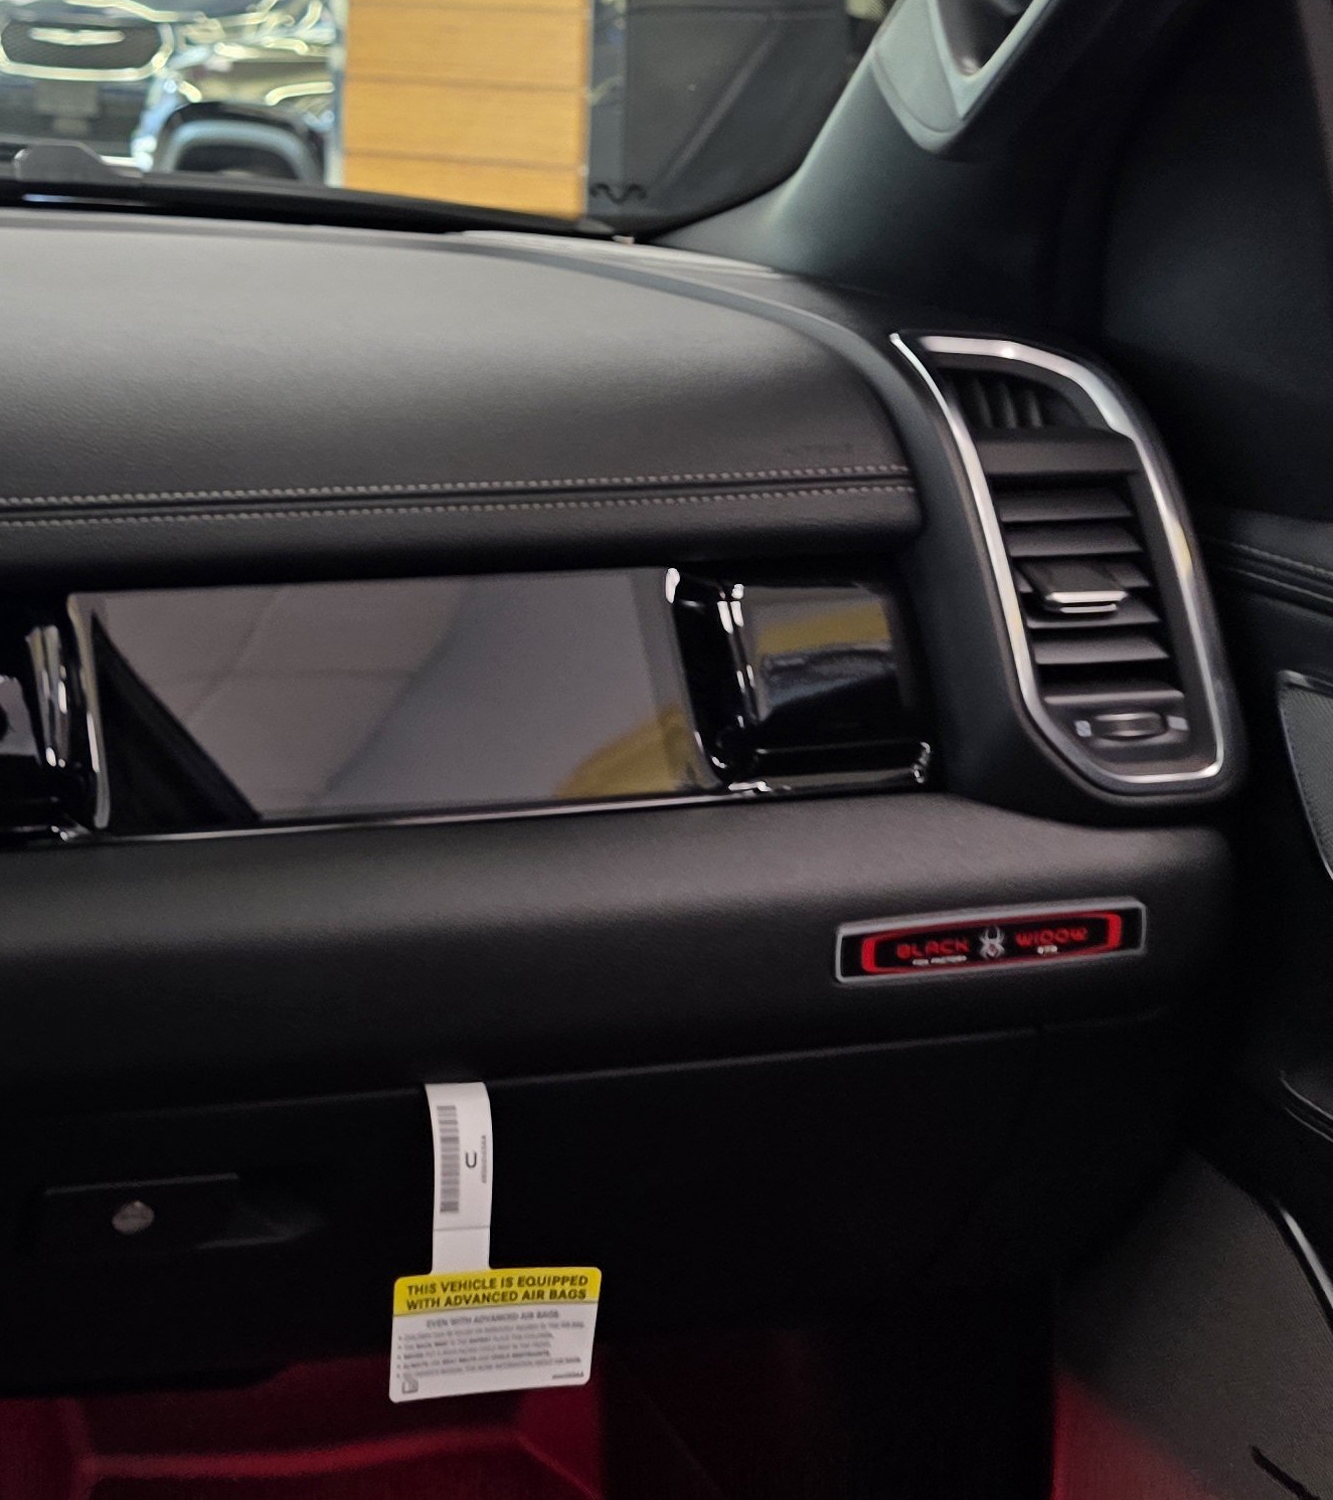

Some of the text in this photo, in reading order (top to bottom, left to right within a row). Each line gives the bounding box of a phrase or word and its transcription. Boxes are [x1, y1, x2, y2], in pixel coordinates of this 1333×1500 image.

[896, 927, 1089, 960] BLACK WIDOW
[406, 1274, 589, 1296] THIS VEHICLE IS EQUIPPED
[406, 1288, 587, 1311] WITH ADVANCED AIR BAGS
